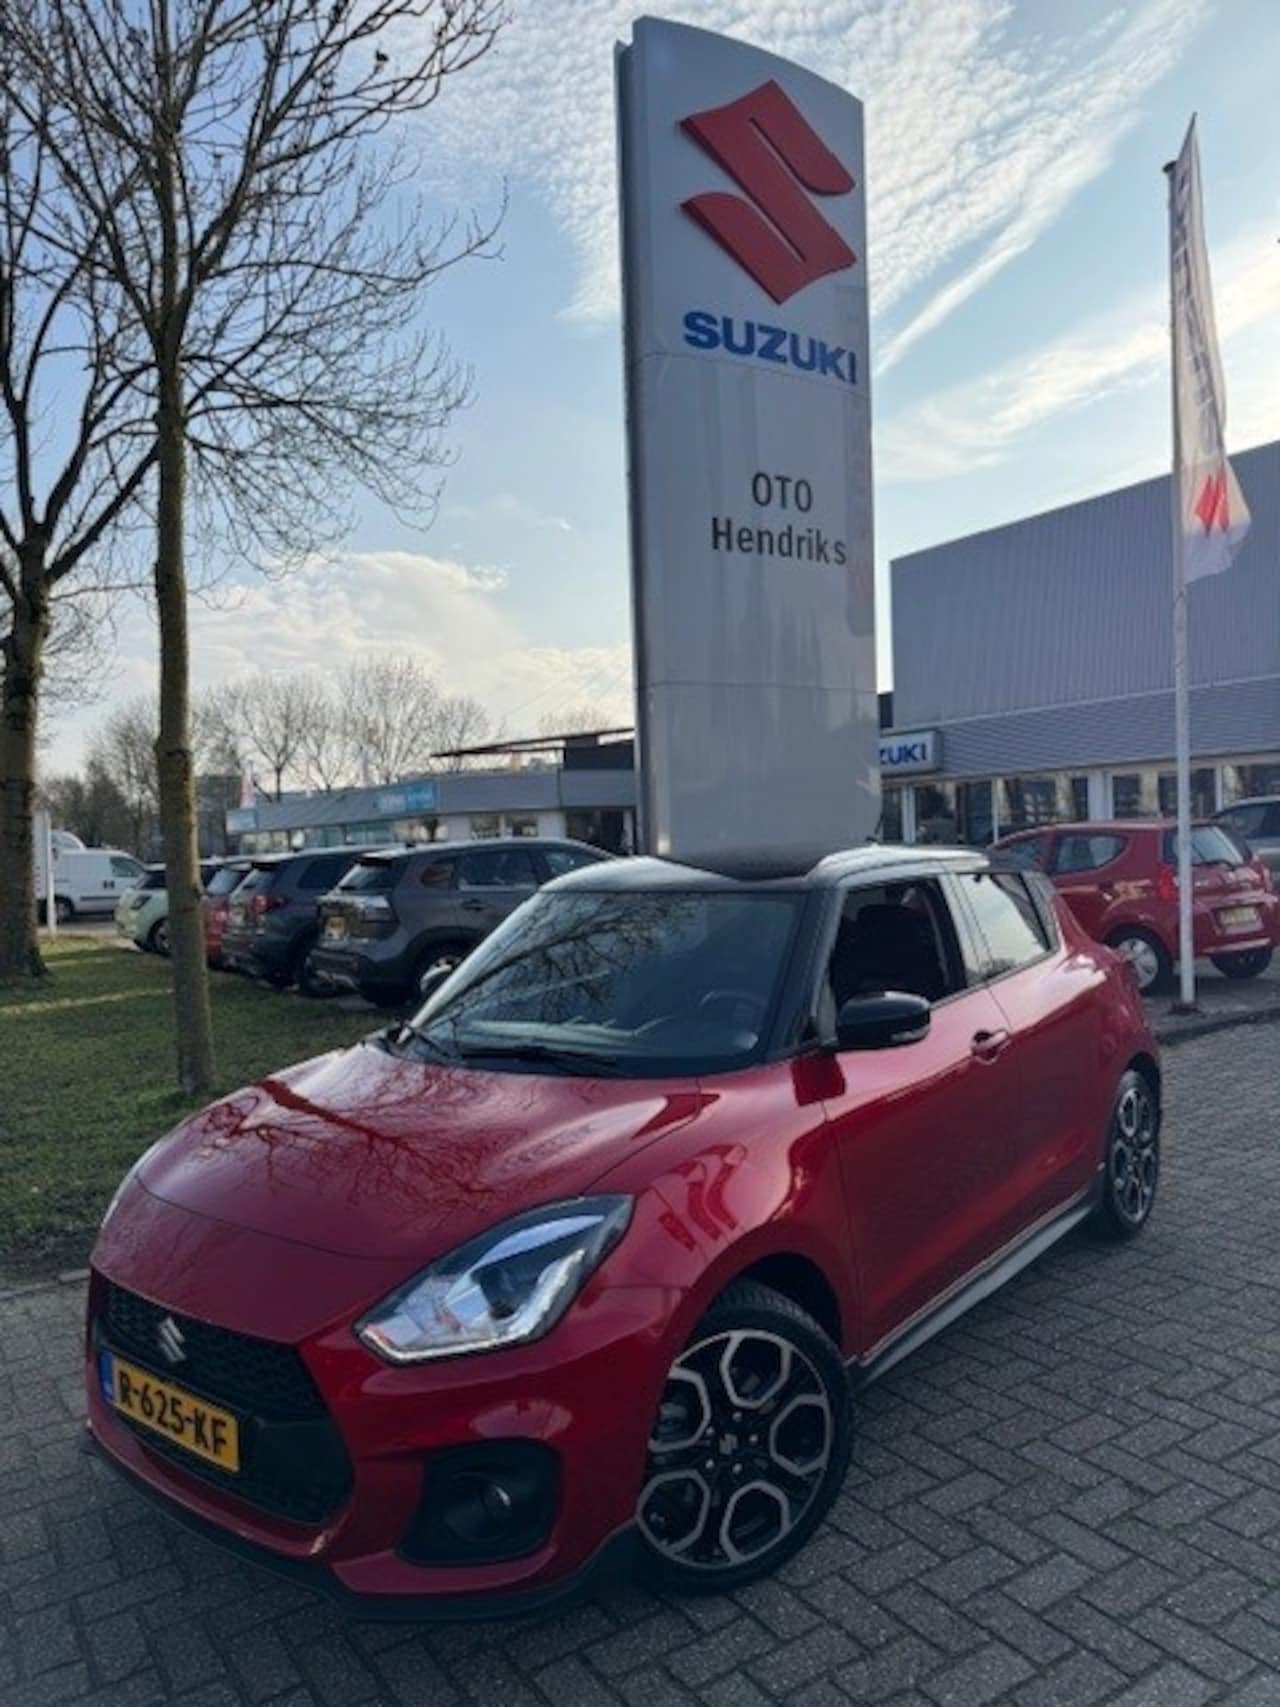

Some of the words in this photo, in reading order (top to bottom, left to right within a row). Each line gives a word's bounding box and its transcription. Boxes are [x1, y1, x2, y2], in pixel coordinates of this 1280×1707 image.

[683, 311, 857, 385] SUZUKI
[751, 472, 813, 513] OTO
[711, 516, 847, 566] Hendriks
[119, 1369, 227, 1455] R-625-KF
